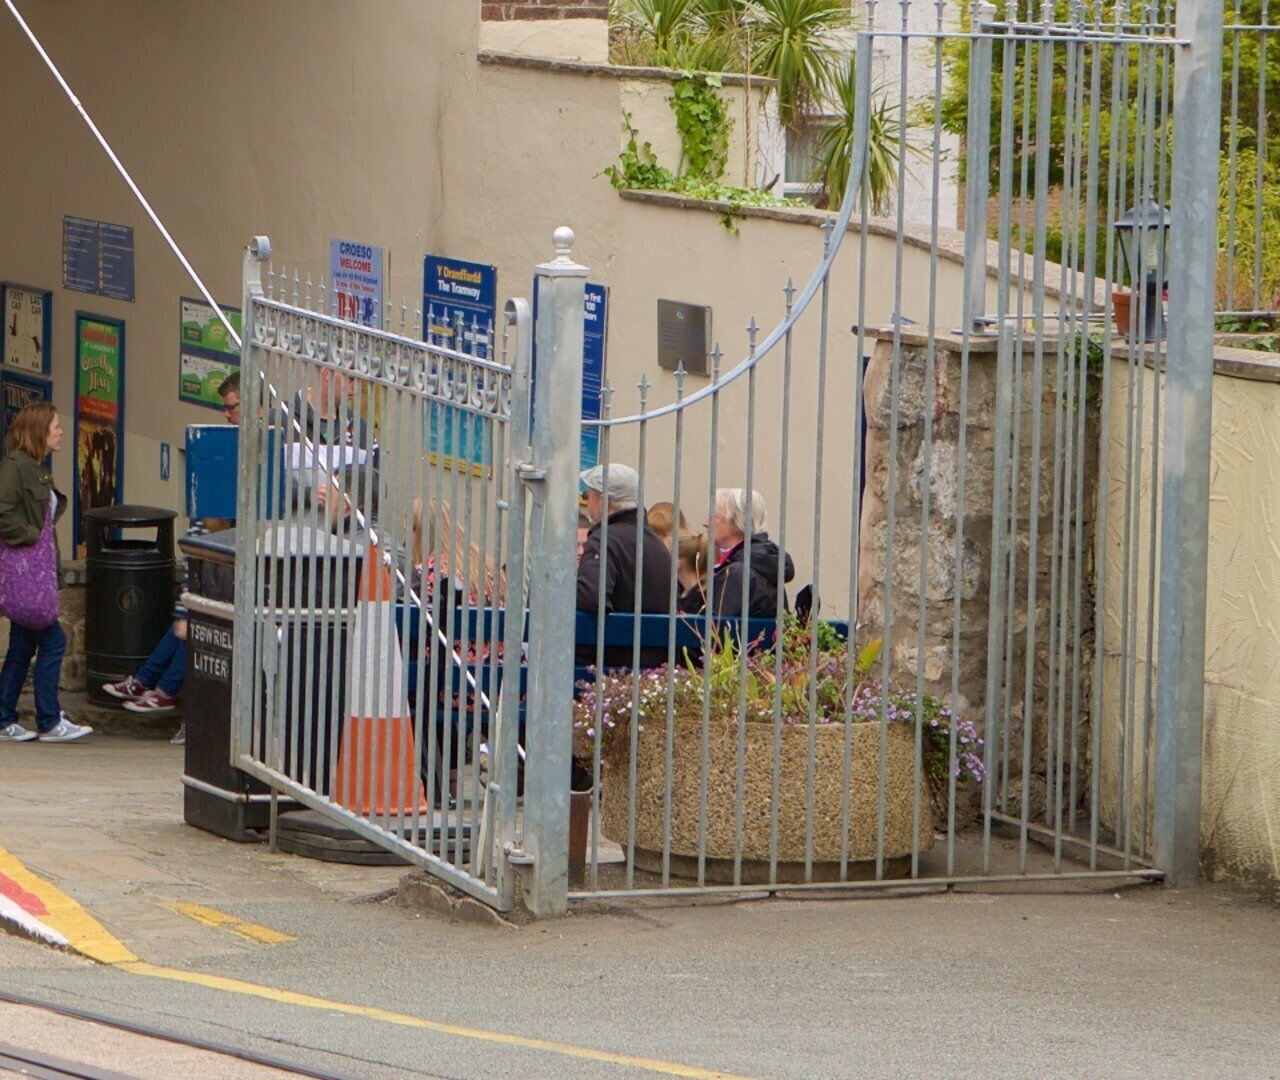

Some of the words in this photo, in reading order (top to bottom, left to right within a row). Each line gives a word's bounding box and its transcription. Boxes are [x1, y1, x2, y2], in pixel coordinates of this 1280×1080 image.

[340, 242, 372, 260] CROESO
[340, 257, 371, 273] WELCOME
[438, 279, 450, 293] The
[451, 282, 480, 300] Tramway
[193, 652, 228, 679] LITTER
